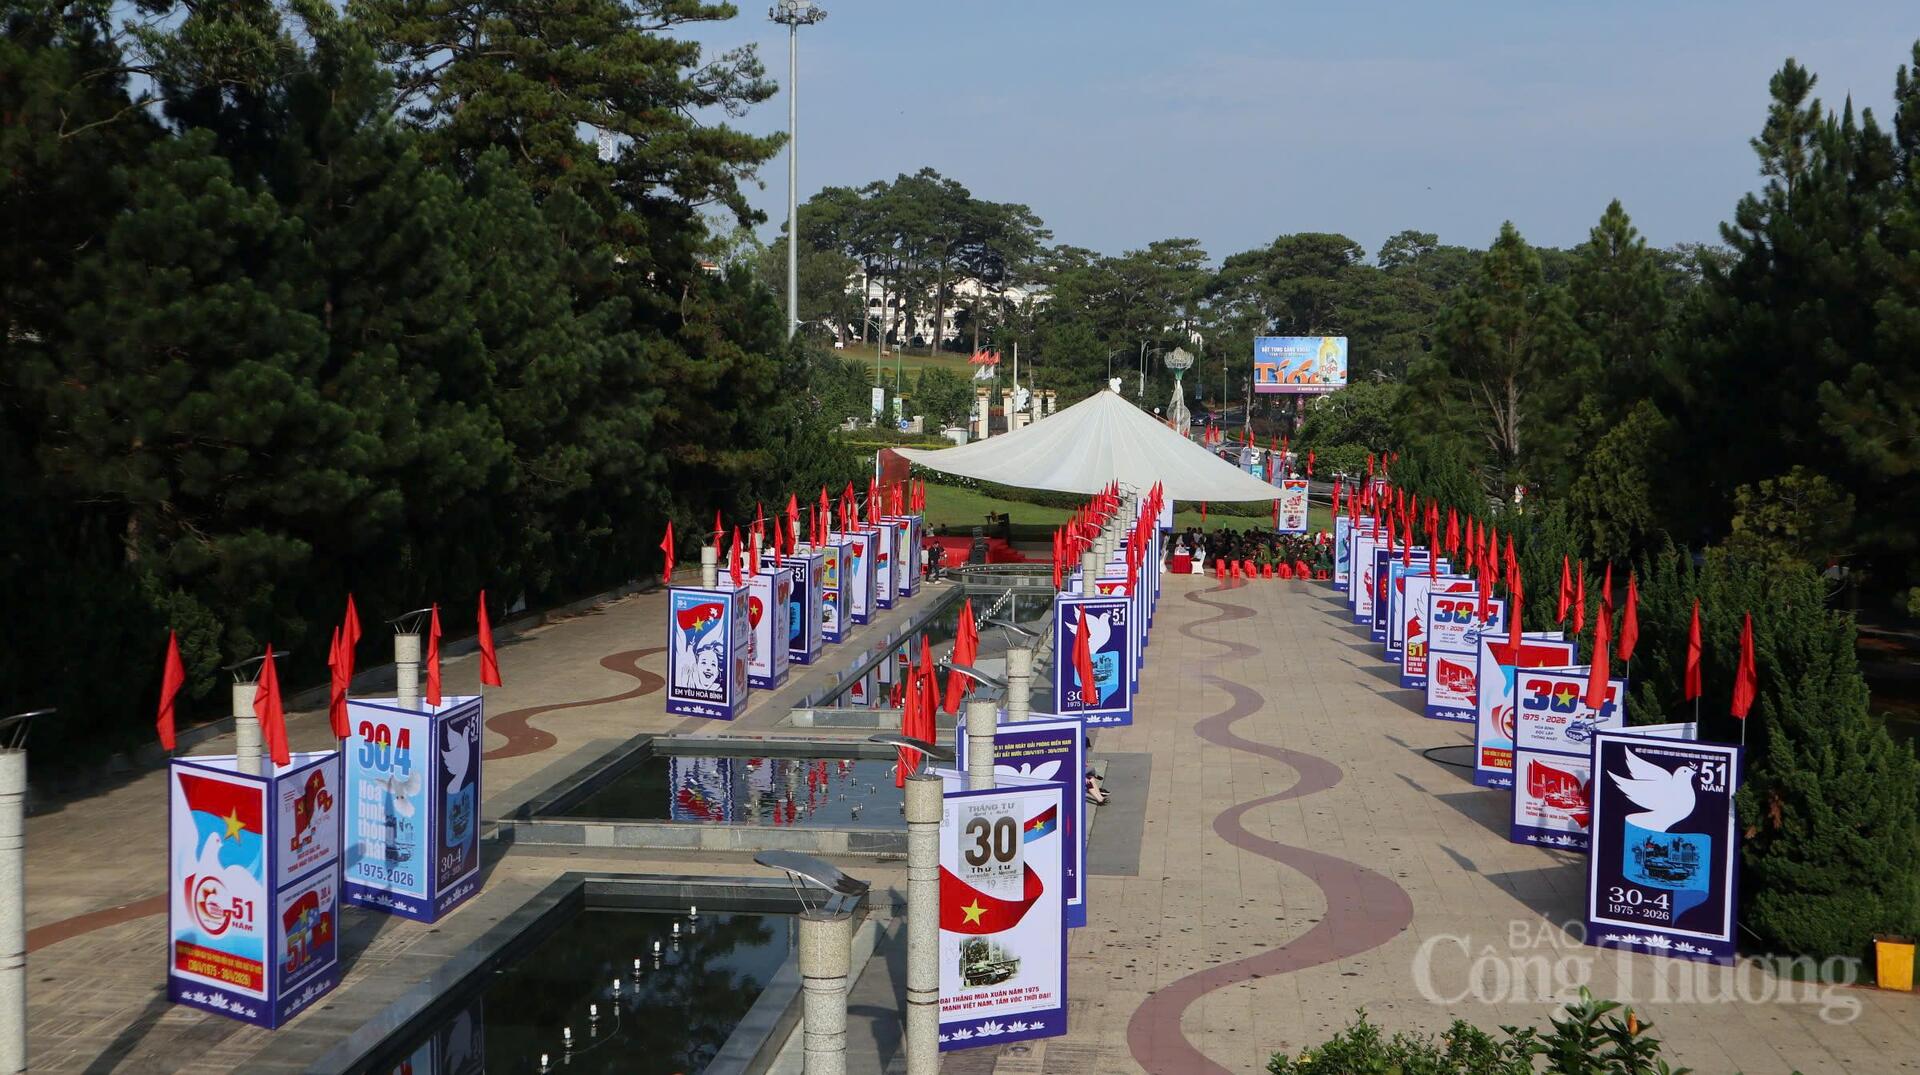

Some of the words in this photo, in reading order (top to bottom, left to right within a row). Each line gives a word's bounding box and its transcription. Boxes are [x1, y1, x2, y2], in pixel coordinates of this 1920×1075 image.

[1112, 608, 1125, 622] 51
[675, 688, 683, 696] EM
[684, 689, 695, 698] YÊU
[1522, 713, 1540, 721] 1975
[1545, 716, 1567, 725] 2026
[358, 720, 412, 776] 30.4
[1700, 761, 1727, 785] 51
[965, 816, 1016, 866] 30
[440, 848, 462, 873] 30-4
[358, 863, 414, 887] 1975.2026
[232, 897, 254, 922] 51
[1608, 886, 1670, 910] 30-4
[1609, 904, 1633, 915] 1975
[1642, 908, 1670, 920] 2026
